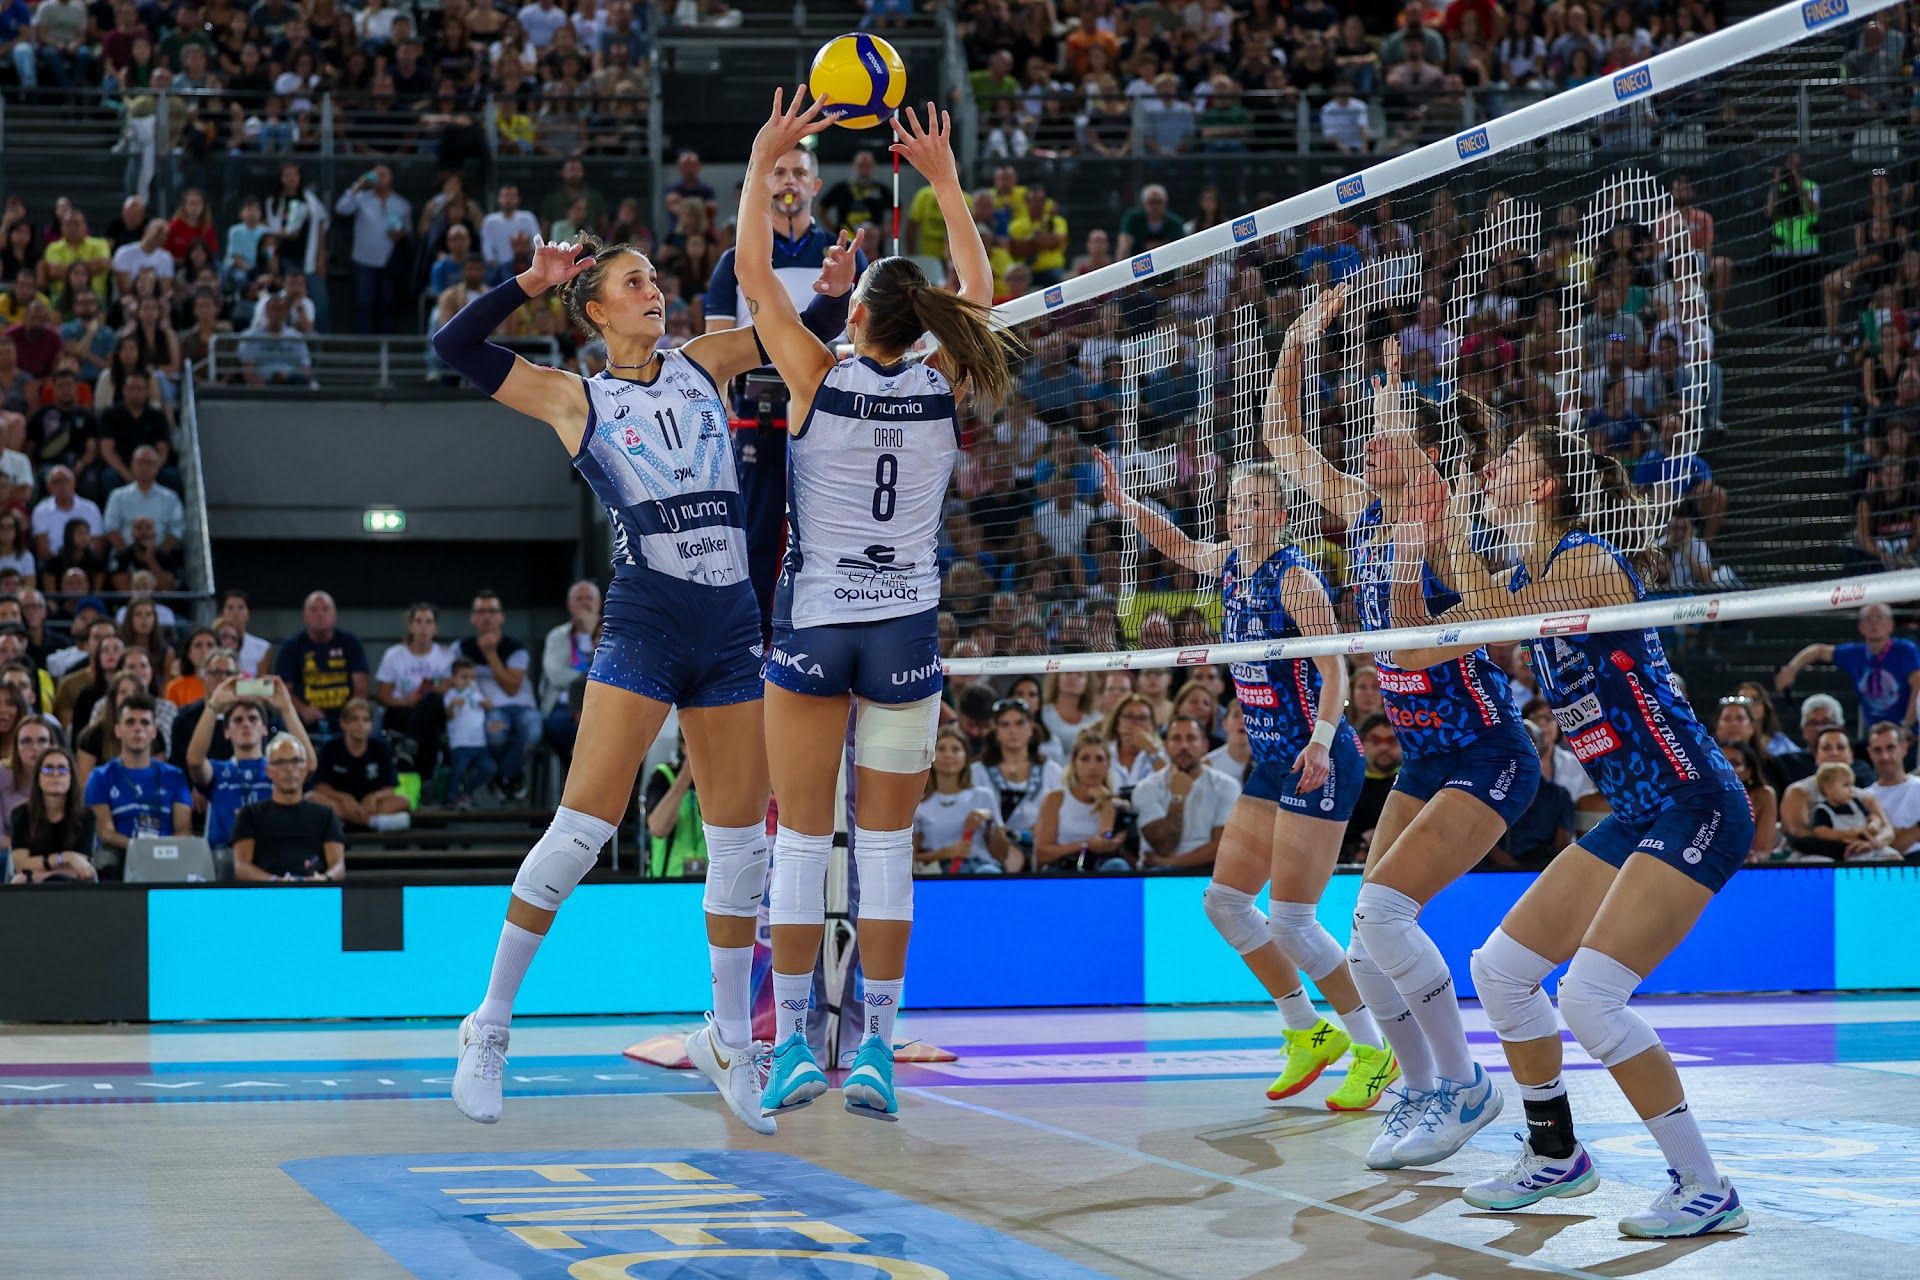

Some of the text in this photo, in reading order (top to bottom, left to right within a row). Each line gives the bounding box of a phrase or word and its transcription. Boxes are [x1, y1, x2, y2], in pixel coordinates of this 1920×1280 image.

[1616, 71, 1649, 94] FINECO
[1458, 132, 1486, 153] FINECO
[1338, 180, 1362, 199] FINECO
[1234, 220, 1255, 237] FINECO
[1133, 257, 1151, 273] FINECO
[1046, 290, 1062, 305] FINECO
[874, 399, 923, 415] numia
[654, 407, 683, 451] 11
[874, 427, 903, 448] ORRO
[872, 453, 898, 522] 8
[680, 496, 728, 520] numa
[771, 647, 825, 679] UNIKA
[1629, 680, 1687, 779] NTERNATIONAL
[1659, 724, 1701, 781] TRADING
[408, 1162, 950, 1280] FINEC
